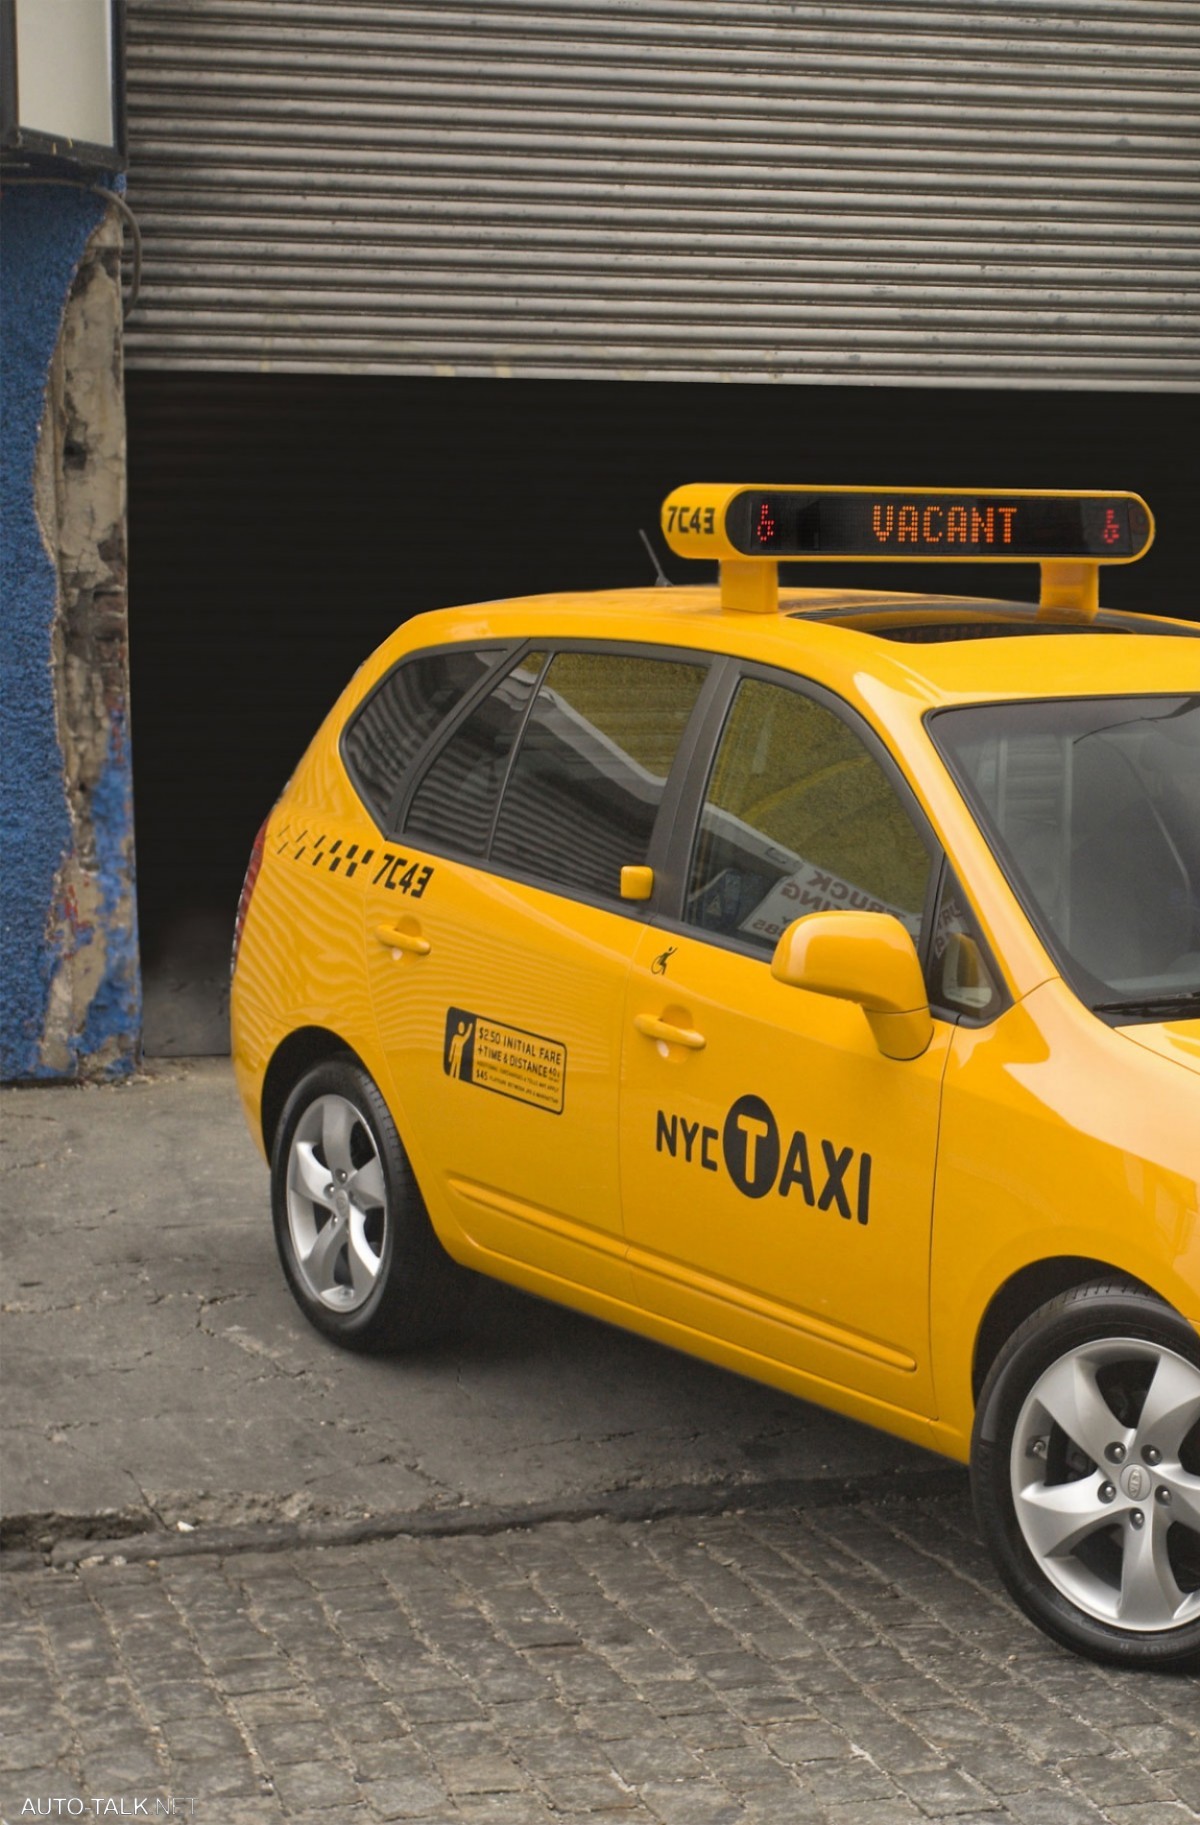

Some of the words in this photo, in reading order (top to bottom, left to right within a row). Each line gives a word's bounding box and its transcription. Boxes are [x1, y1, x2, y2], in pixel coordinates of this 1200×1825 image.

[668, 506, 715, 534] 7C43
[873, 505, 1017, 543] VACANT
[373, 854, 434, 898] 7C43
[503, 1036, 536, 1057] INITIAL
[539, 1047, 561, 1065] FARE
[510, 1055, 548, 1077] DISTANCE
[656, 1110, 718, 1172] NYC
[735, 1111, 872, 1226] TAXI
